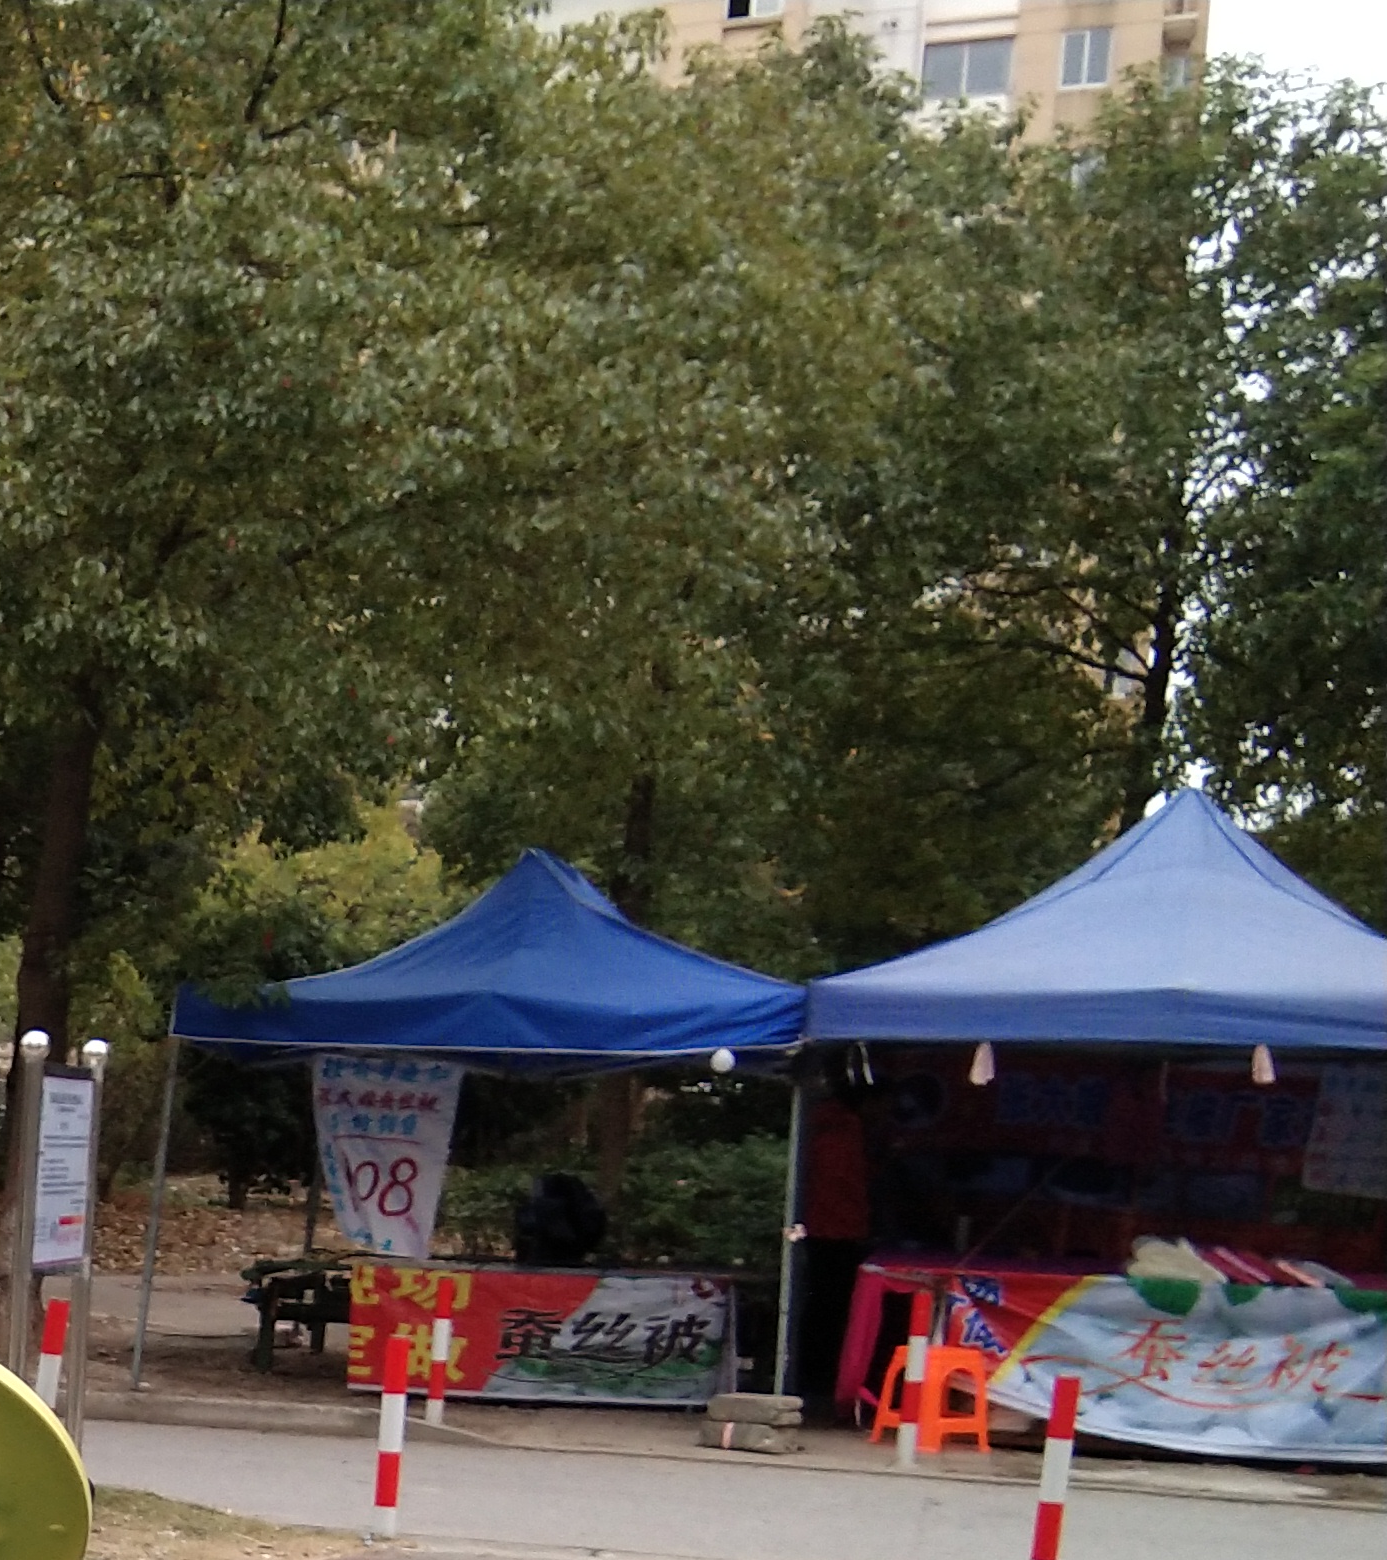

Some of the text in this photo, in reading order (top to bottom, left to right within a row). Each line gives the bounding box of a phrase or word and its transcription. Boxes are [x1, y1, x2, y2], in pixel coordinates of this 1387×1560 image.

[494, 1306, 711, 1367] 蚕丝被
[1113, 1317, 1351, 1393] 蚕丝被
